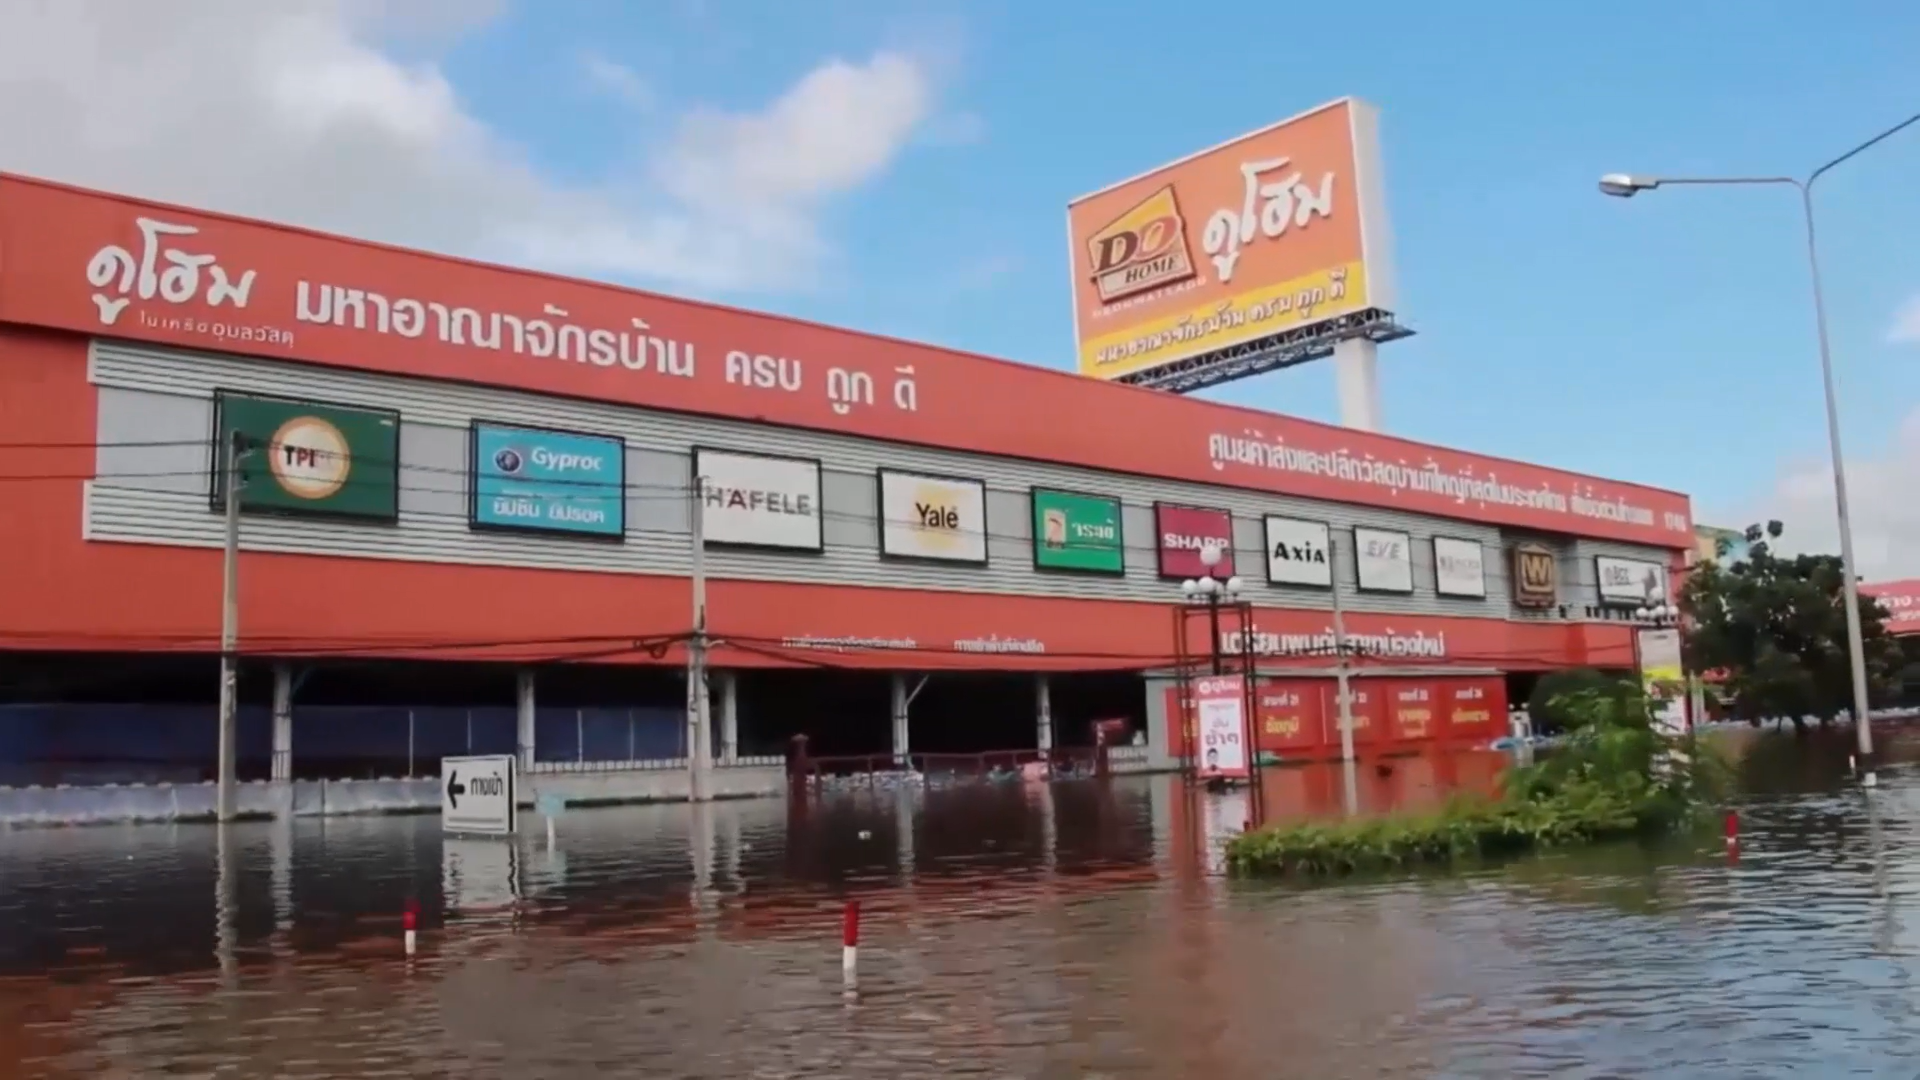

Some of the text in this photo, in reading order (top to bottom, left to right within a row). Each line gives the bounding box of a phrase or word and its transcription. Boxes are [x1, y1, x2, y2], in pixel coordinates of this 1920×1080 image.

[1202, 156, 1335, 282] ดูโฮม
[1096, 215, 1179, 273] DO
[87, 217, 257, 326] ดูโฮม
[1124, 254, 1180, 285] HOME
[1296, 286, 1325, 320] ถูก
[1329, 267, 1347, 299] ดี
[295, 279, 918, 416] มหาอาณาจักรบ้าน ครบ ถูก ดี
[283, 445, 316, 468] TPI
[531, 446, 603, 472] Gyproc
[706, 487, 812, 517] HÄFELE
[915, 502, 959, 529] Yale
[1164, 532, 1229, 551] SHARP
